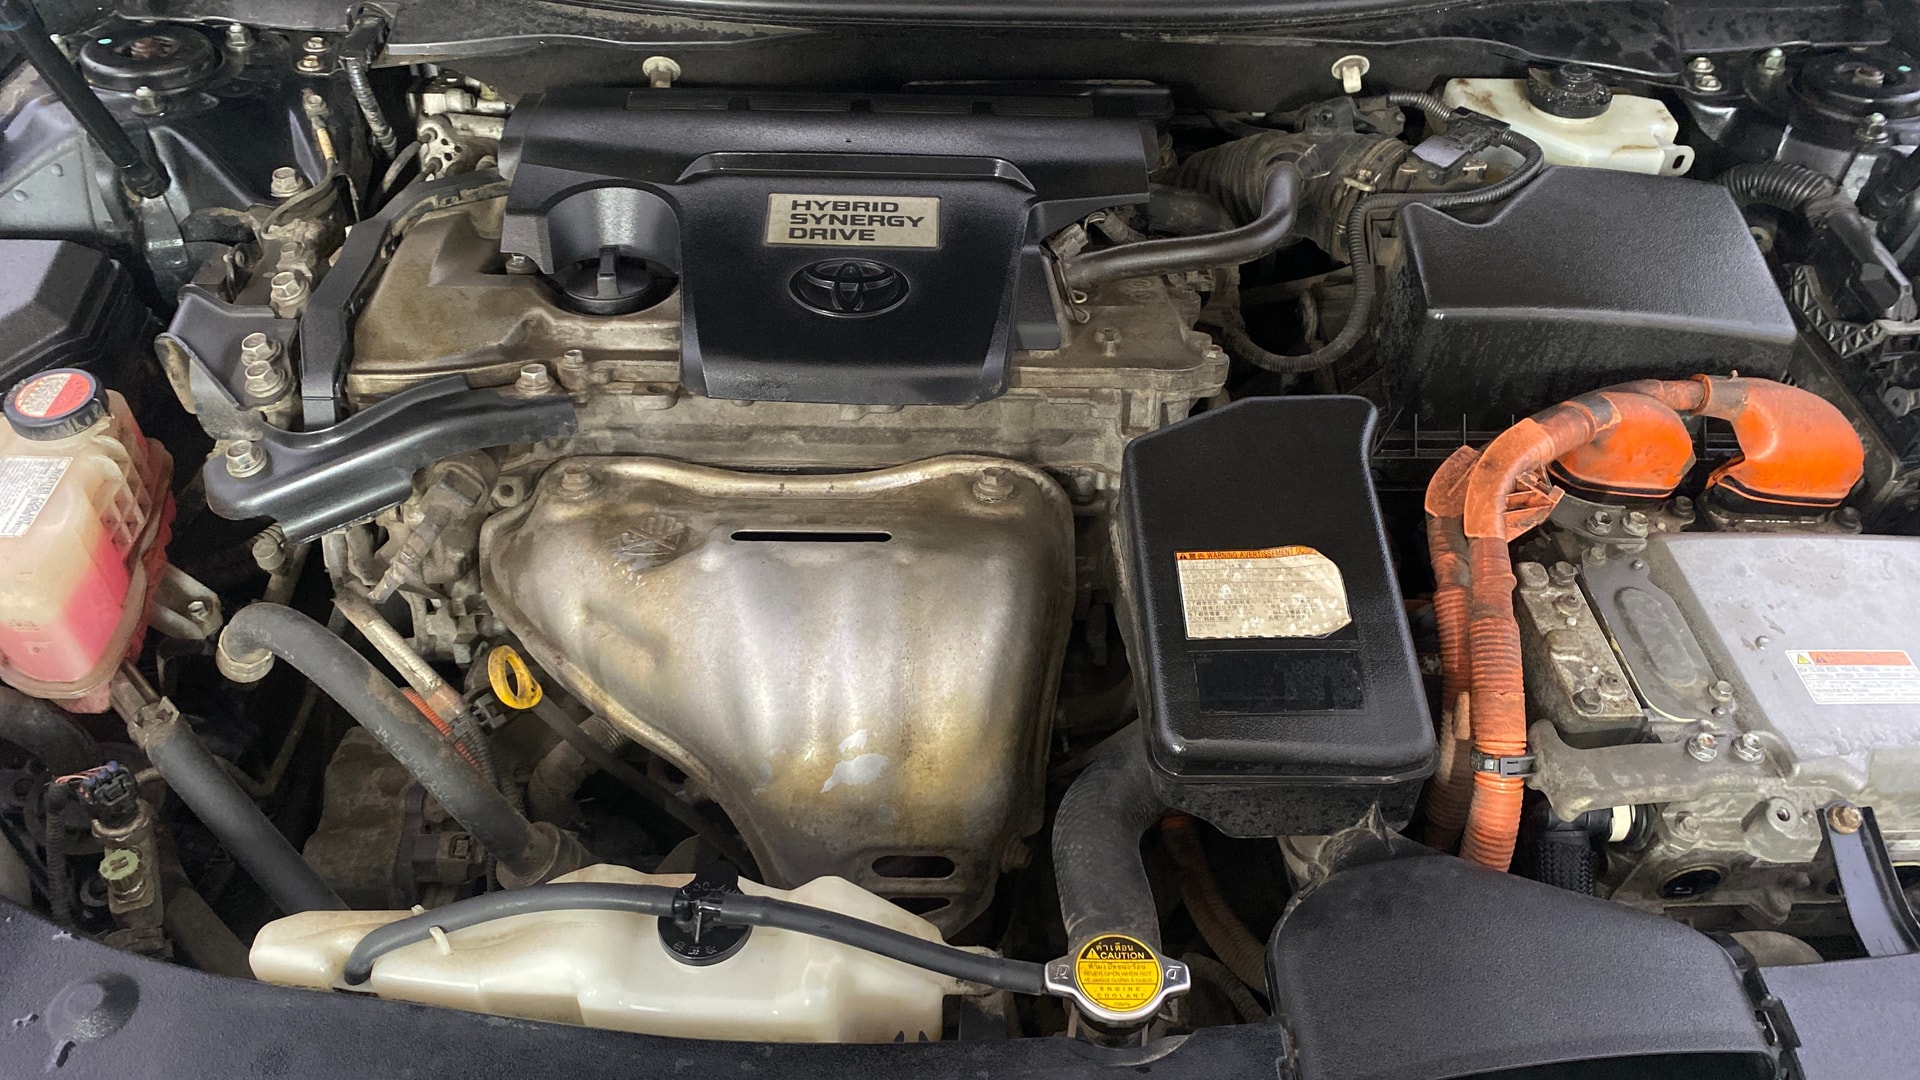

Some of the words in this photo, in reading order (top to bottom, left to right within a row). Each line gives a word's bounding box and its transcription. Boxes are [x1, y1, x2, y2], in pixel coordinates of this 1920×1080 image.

[791, 200, 899, 213] HYBRID
[789, 213, 925, 228] SYNERGY
[788, 227, 876, 241] DRIVE
[1206, 551, 1238, 560] WARNING
[1239, 547, 1294, 559] AVERTISSEMENT
[1100, 951, 1145, 960] CAUTION
